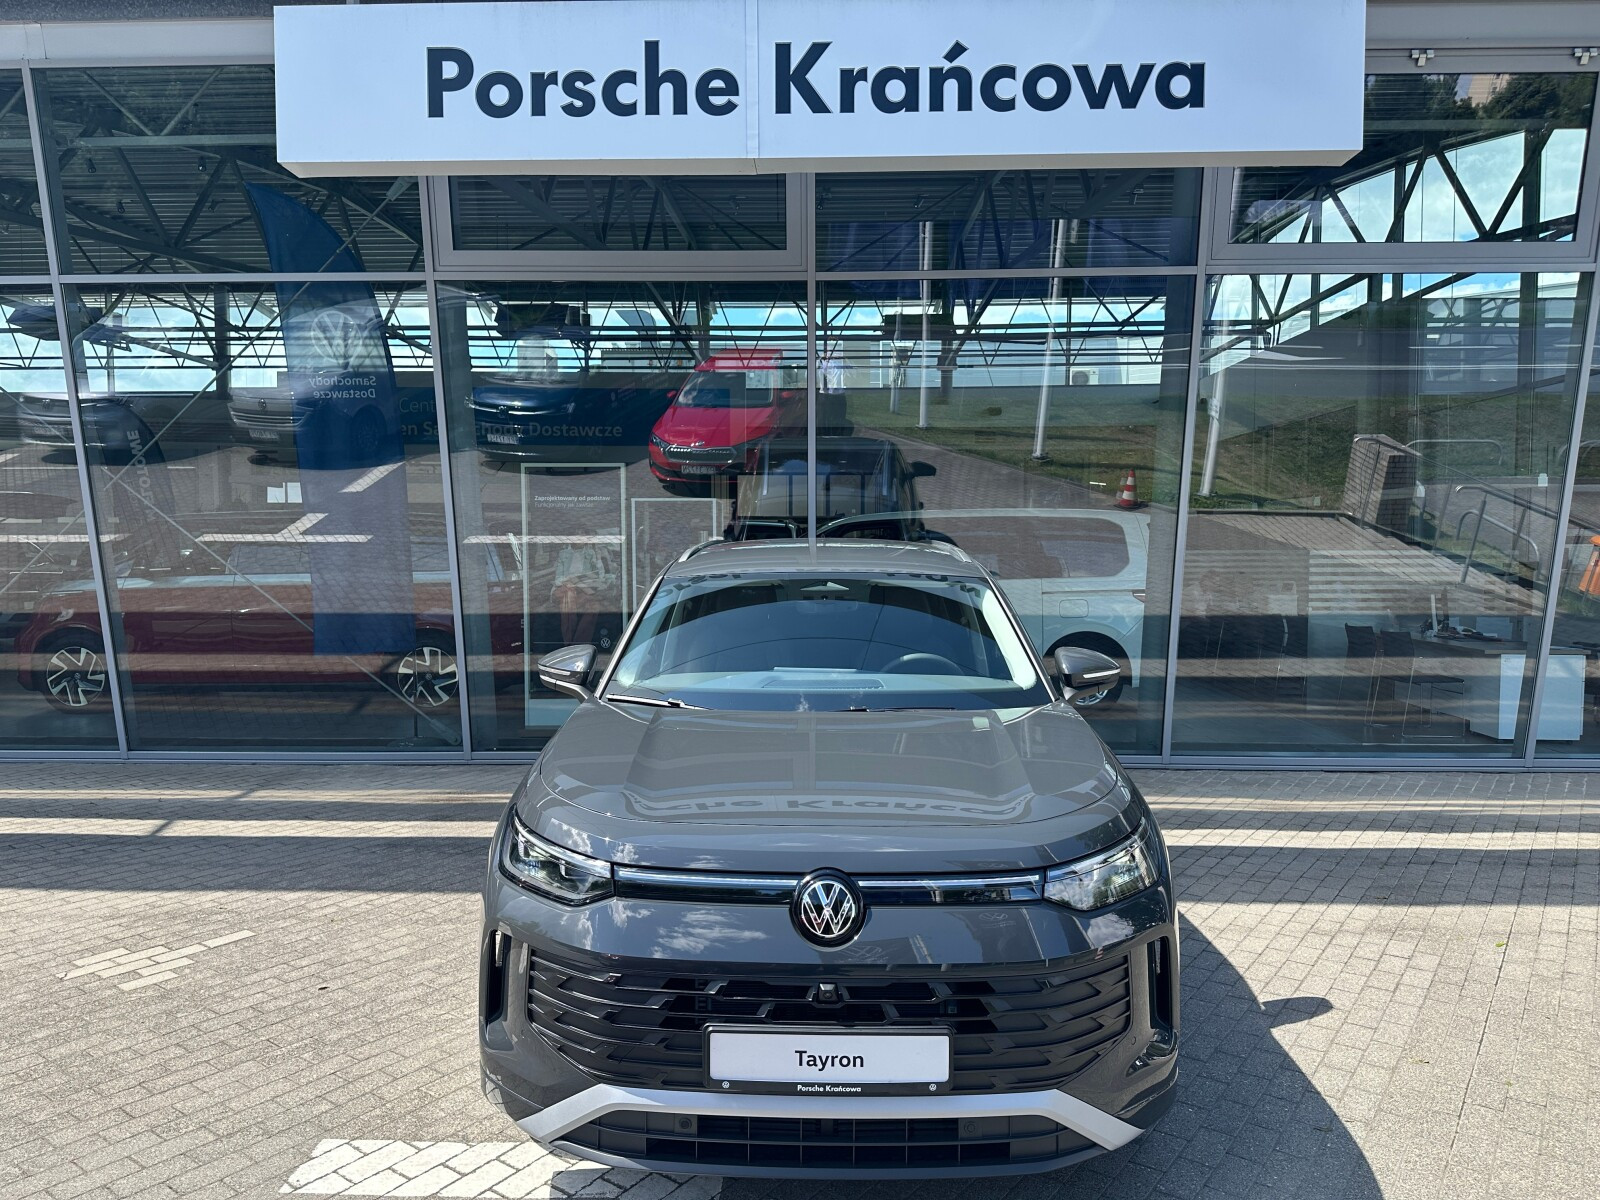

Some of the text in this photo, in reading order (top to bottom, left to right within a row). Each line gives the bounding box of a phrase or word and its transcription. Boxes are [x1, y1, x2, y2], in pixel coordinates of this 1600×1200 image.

[427, 40, 1206, 118] Porsche Krańcowa
[529, 421, 623, 437] Dostawcze
[795, 1050, 864, 1071] Tayron
[797, 1084, 861, 1092] Porsche Krańcowa
